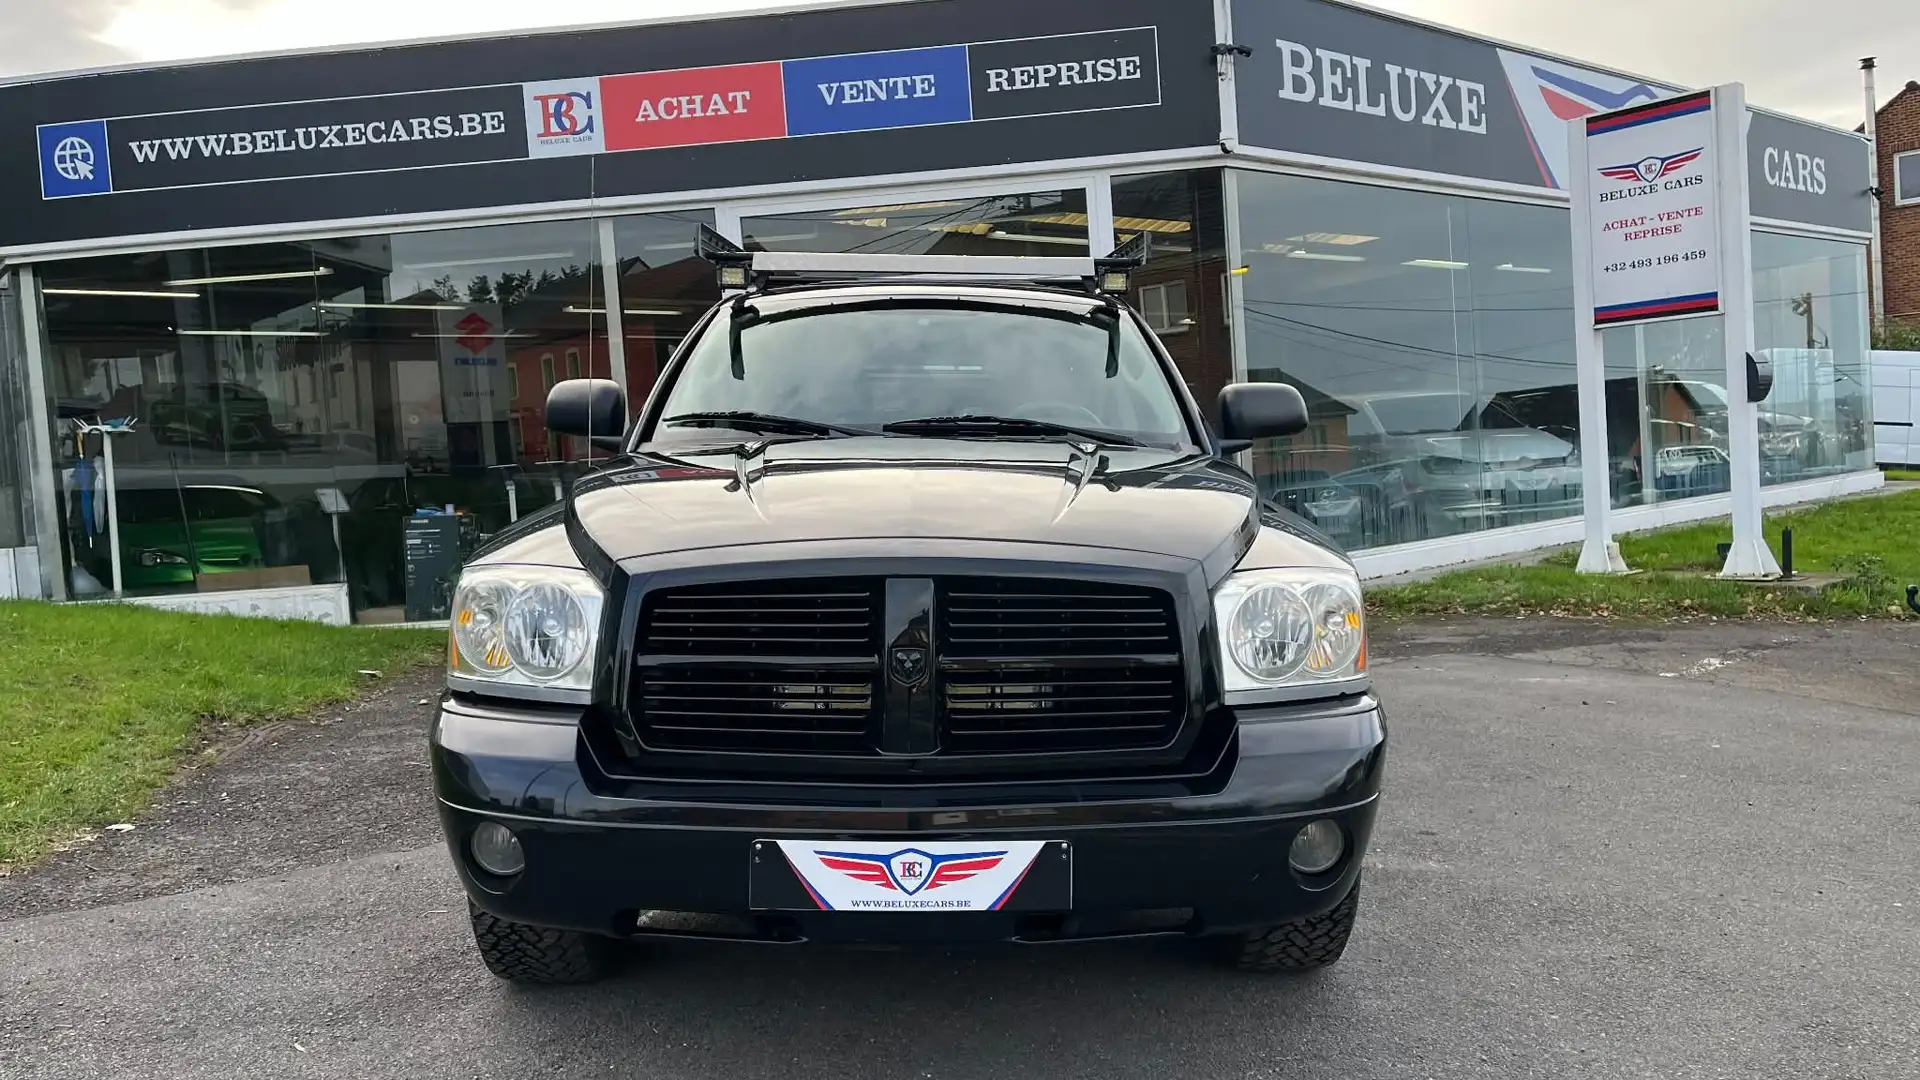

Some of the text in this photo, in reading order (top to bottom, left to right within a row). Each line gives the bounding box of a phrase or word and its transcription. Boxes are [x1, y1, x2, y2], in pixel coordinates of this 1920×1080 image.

[817, 74, 937, 107] VENTE
[986, 56, 1142, 93] REPRISE
[1276, 38, 1487, 135] BELUXE
[635, 90, 750, 123] ACHAT
[129, 111, 506, 164] WWW.BELUXECARS.BE
[1763, 146, 1828, 196] CARS
[1599, 174, 1704, 203] BELUXE CARS
[1603, 216, 1647, 232] ACHAT
[1657, 206, 1703, 223] VENTE
[1624, 224, 1682, 242] REPRISE
[1604, 249, 1707, 273] +32 493 196 459
[851, 900, 971, 909] WWW.BELUXECARS.BE
